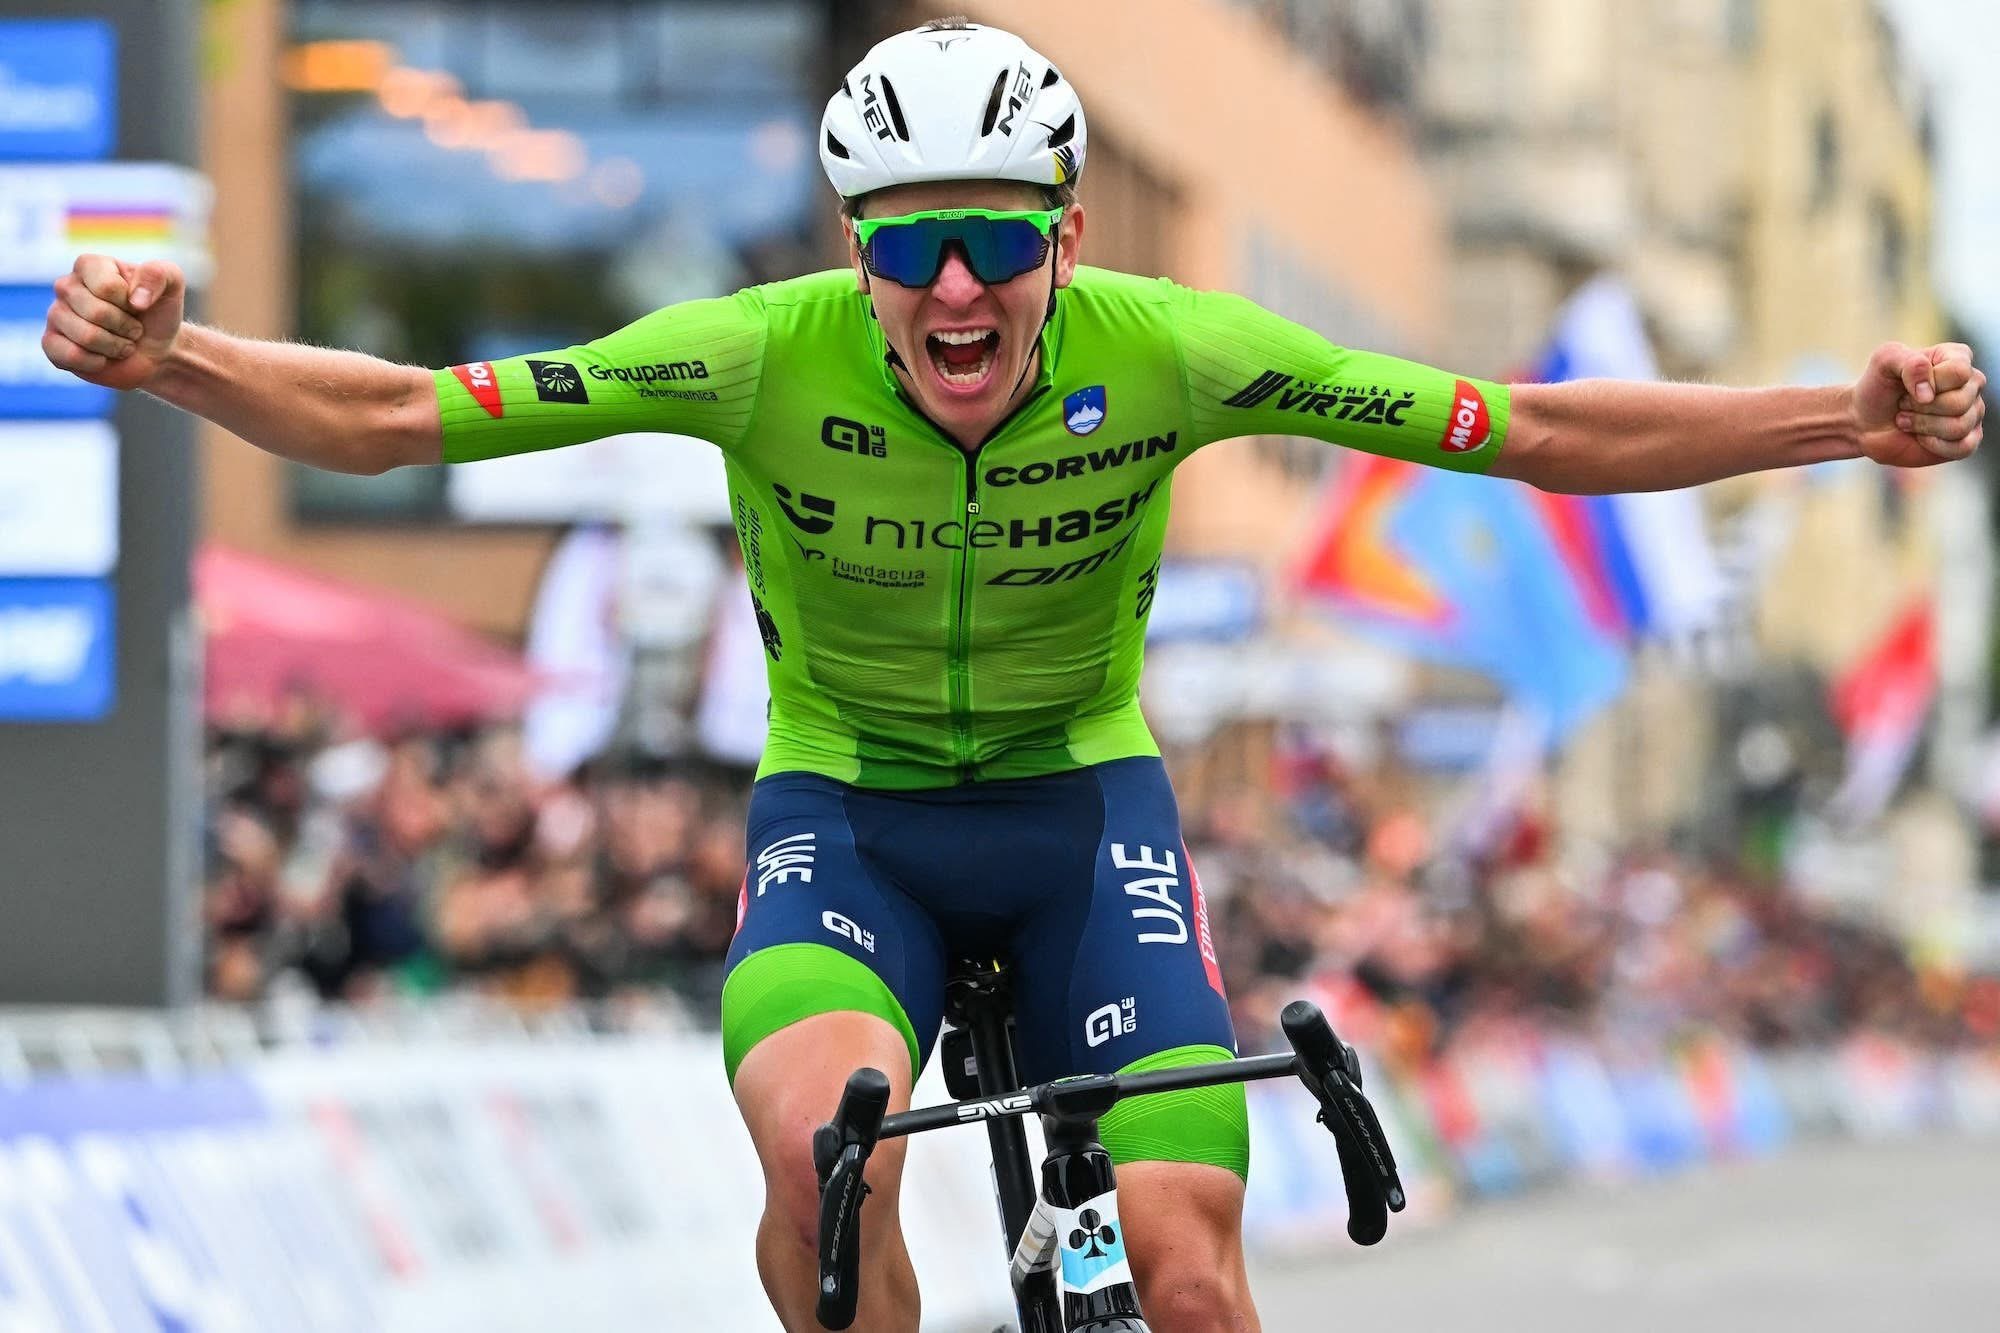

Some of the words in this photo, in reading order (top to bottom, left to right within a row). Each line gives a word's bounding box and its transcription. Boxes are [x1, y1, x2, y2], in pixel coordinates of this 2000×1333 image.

[860, 74, 896, 143] MET
[997, 60, 1034, 137] MET
[587, 359, 709, 385] Groupama
[639, 387, 719, 402] Zavarovalnica
[1296, 380, 1392, 397] AVTOHIŠA
[1276, 388, 1415, 427] VRTAČ
[984, 431, 1177, 488] CORWIN
[756, 832, 816, 898] UAE
[1110, 842, 1189, 945] UAE
